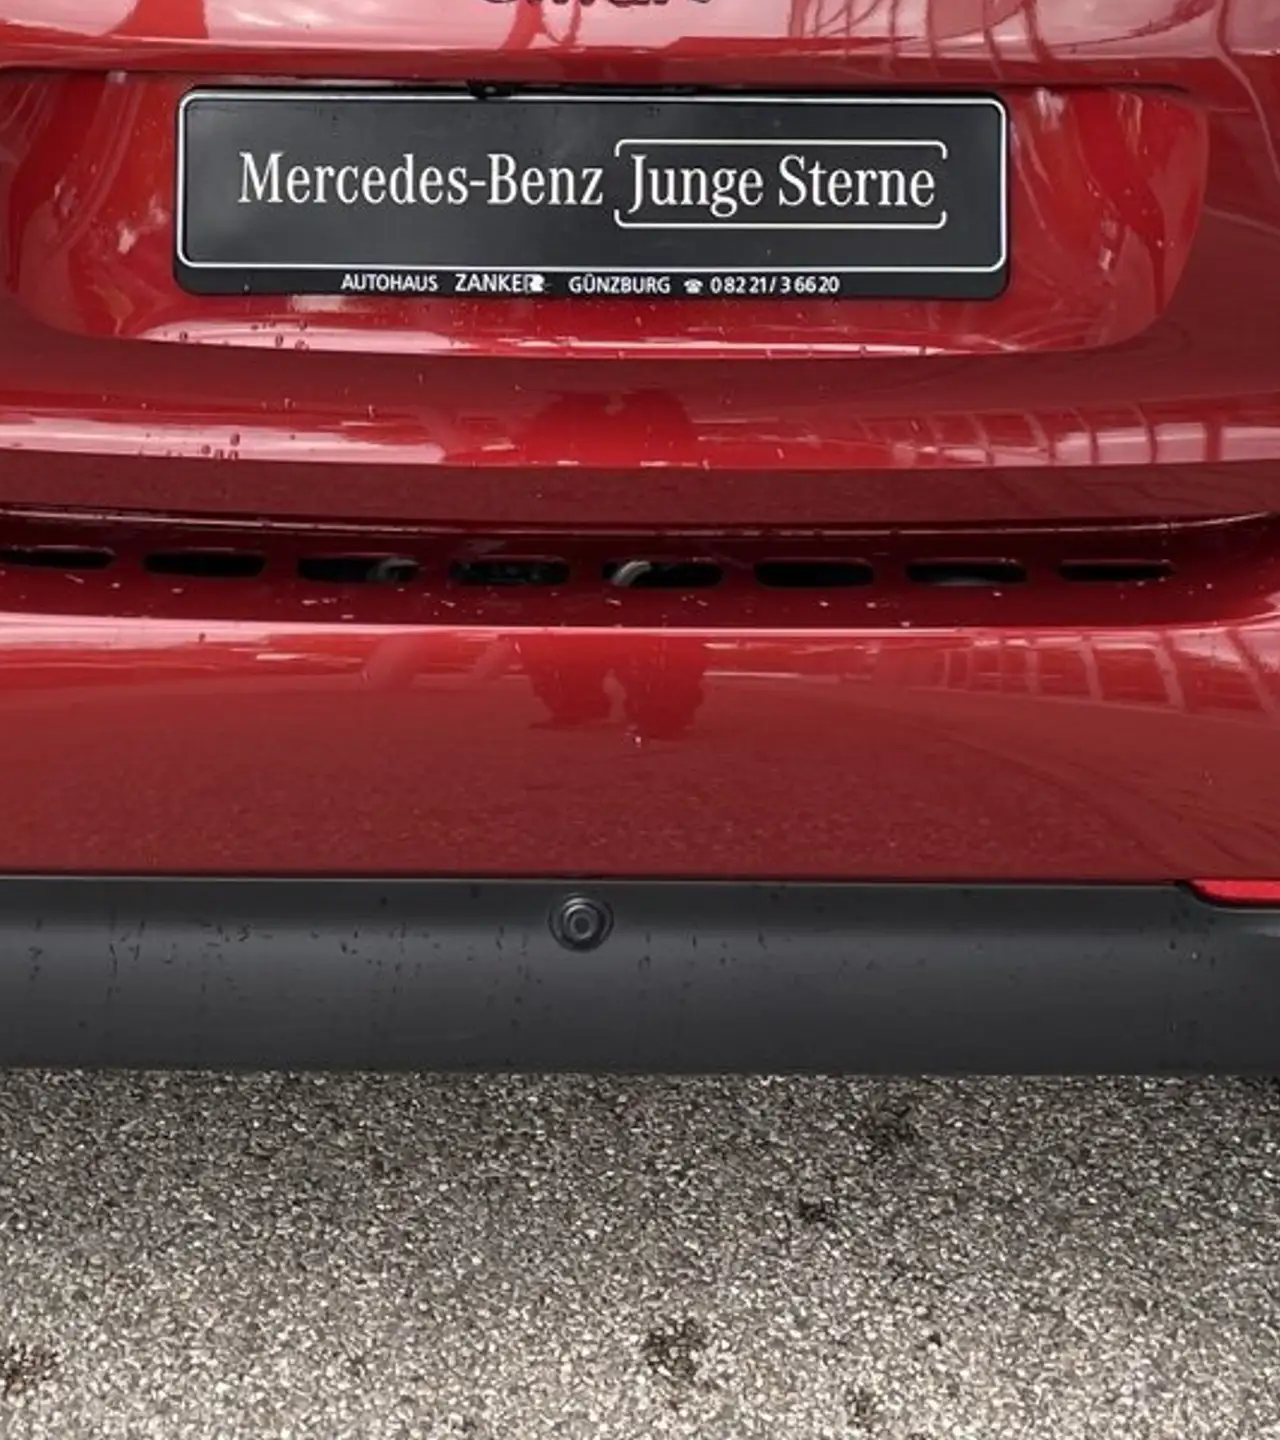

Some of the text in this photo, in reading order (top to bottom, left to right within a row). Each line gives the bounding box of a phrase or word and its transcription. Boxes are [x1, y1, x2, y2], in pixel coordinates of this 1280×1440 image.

[238, 152, 935, 218] Mercedes-Benz Junge Sterne
[341, 274, 438, 293] AUTOHAUS
[569, 273, 671, 295] GÜNZBURG
